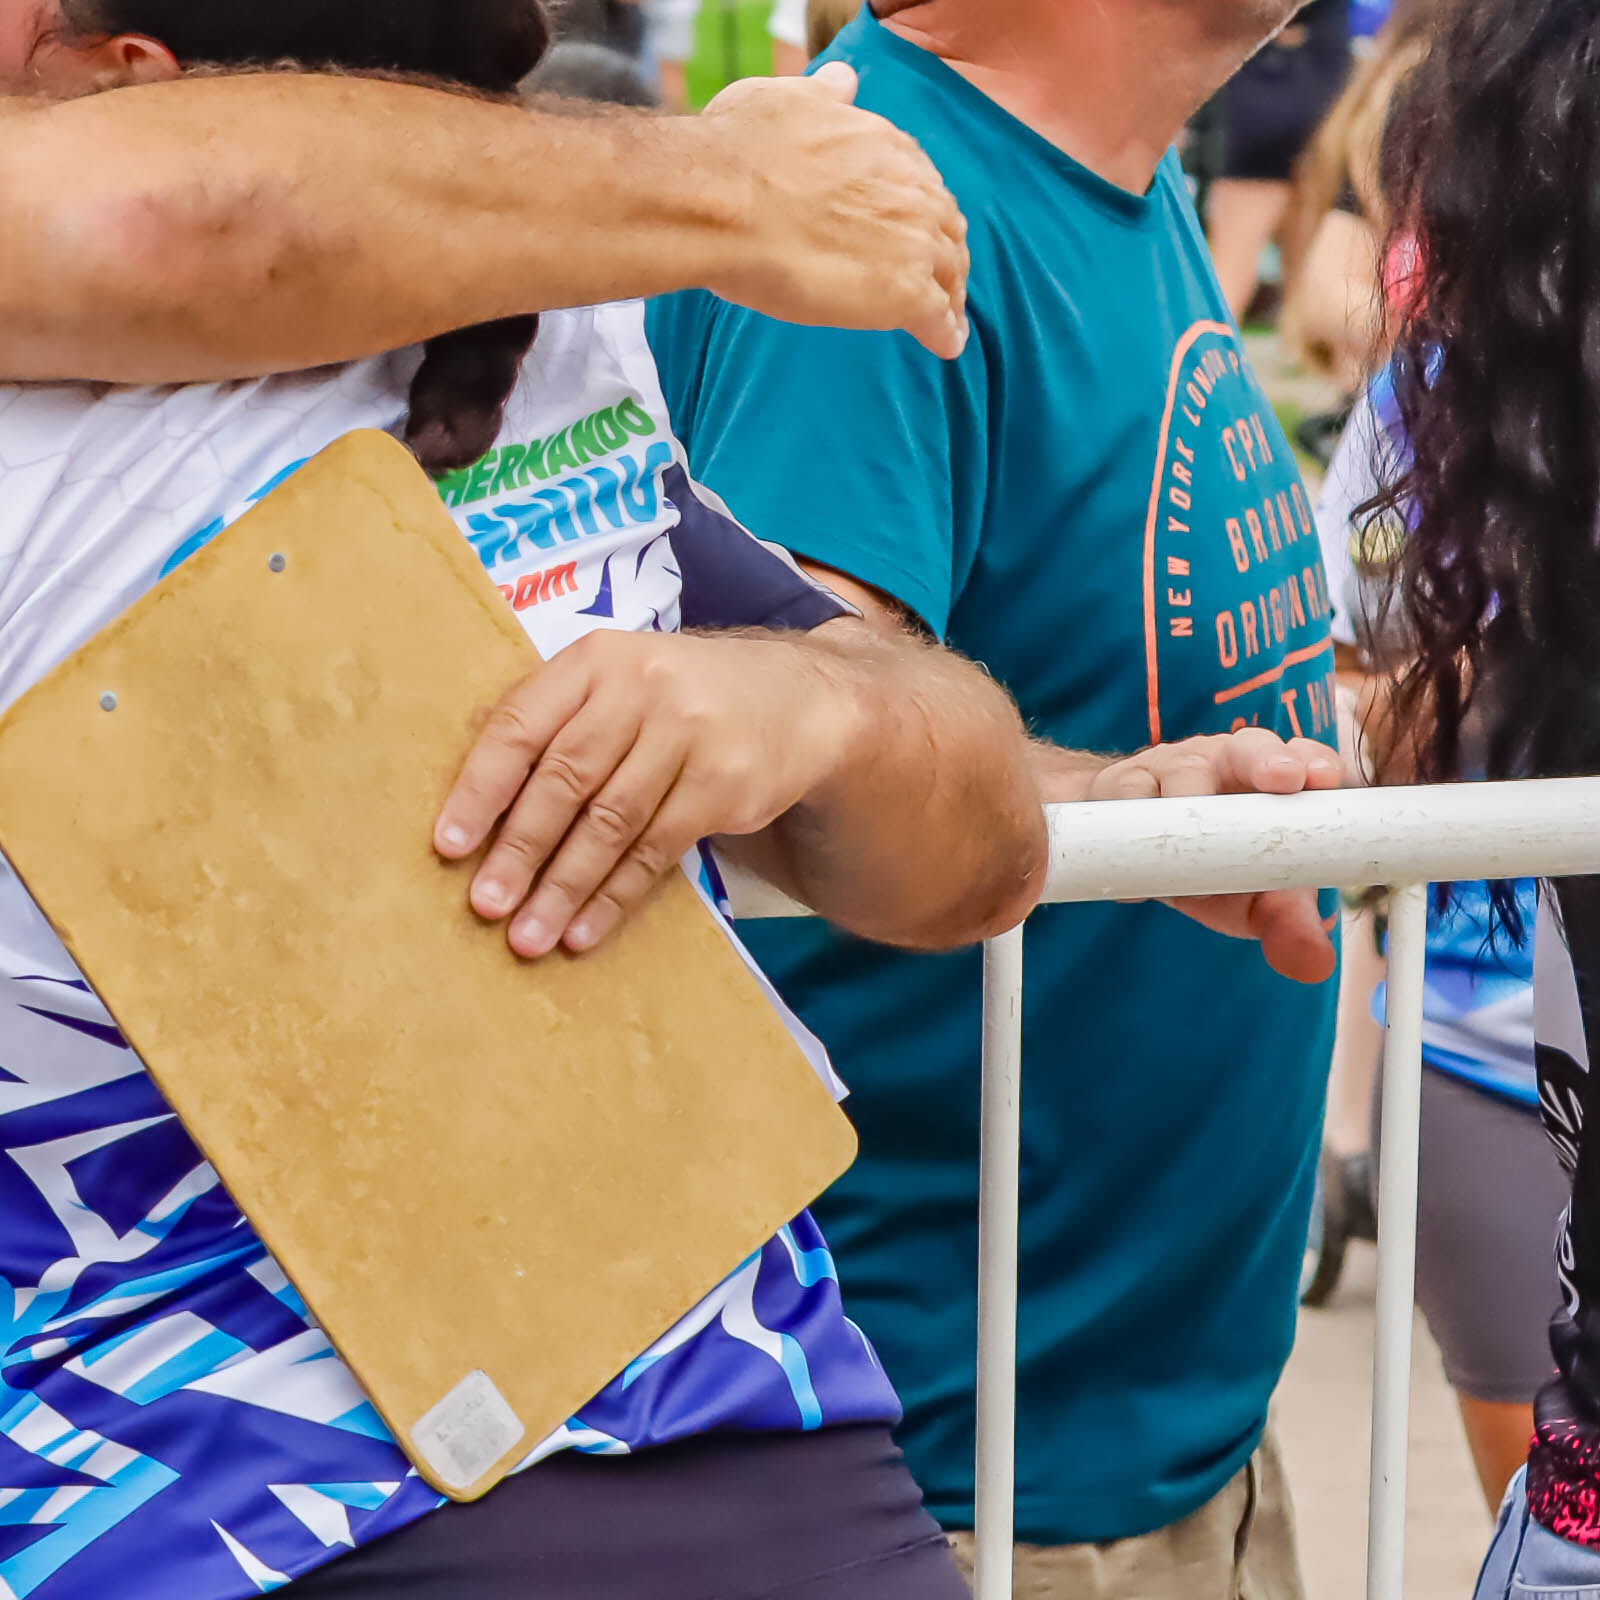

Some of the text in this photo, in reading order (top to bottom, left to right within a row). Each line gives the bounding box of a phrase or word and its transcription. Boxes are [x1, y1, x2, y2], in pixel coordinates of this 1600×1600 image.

[1167, 436, 1195, 533] YORK
[1221, 412, 1274, 482] CPH
[1224, 482, 1313, 574] BRAND
[1166, 555, 1194, 637] NEW
